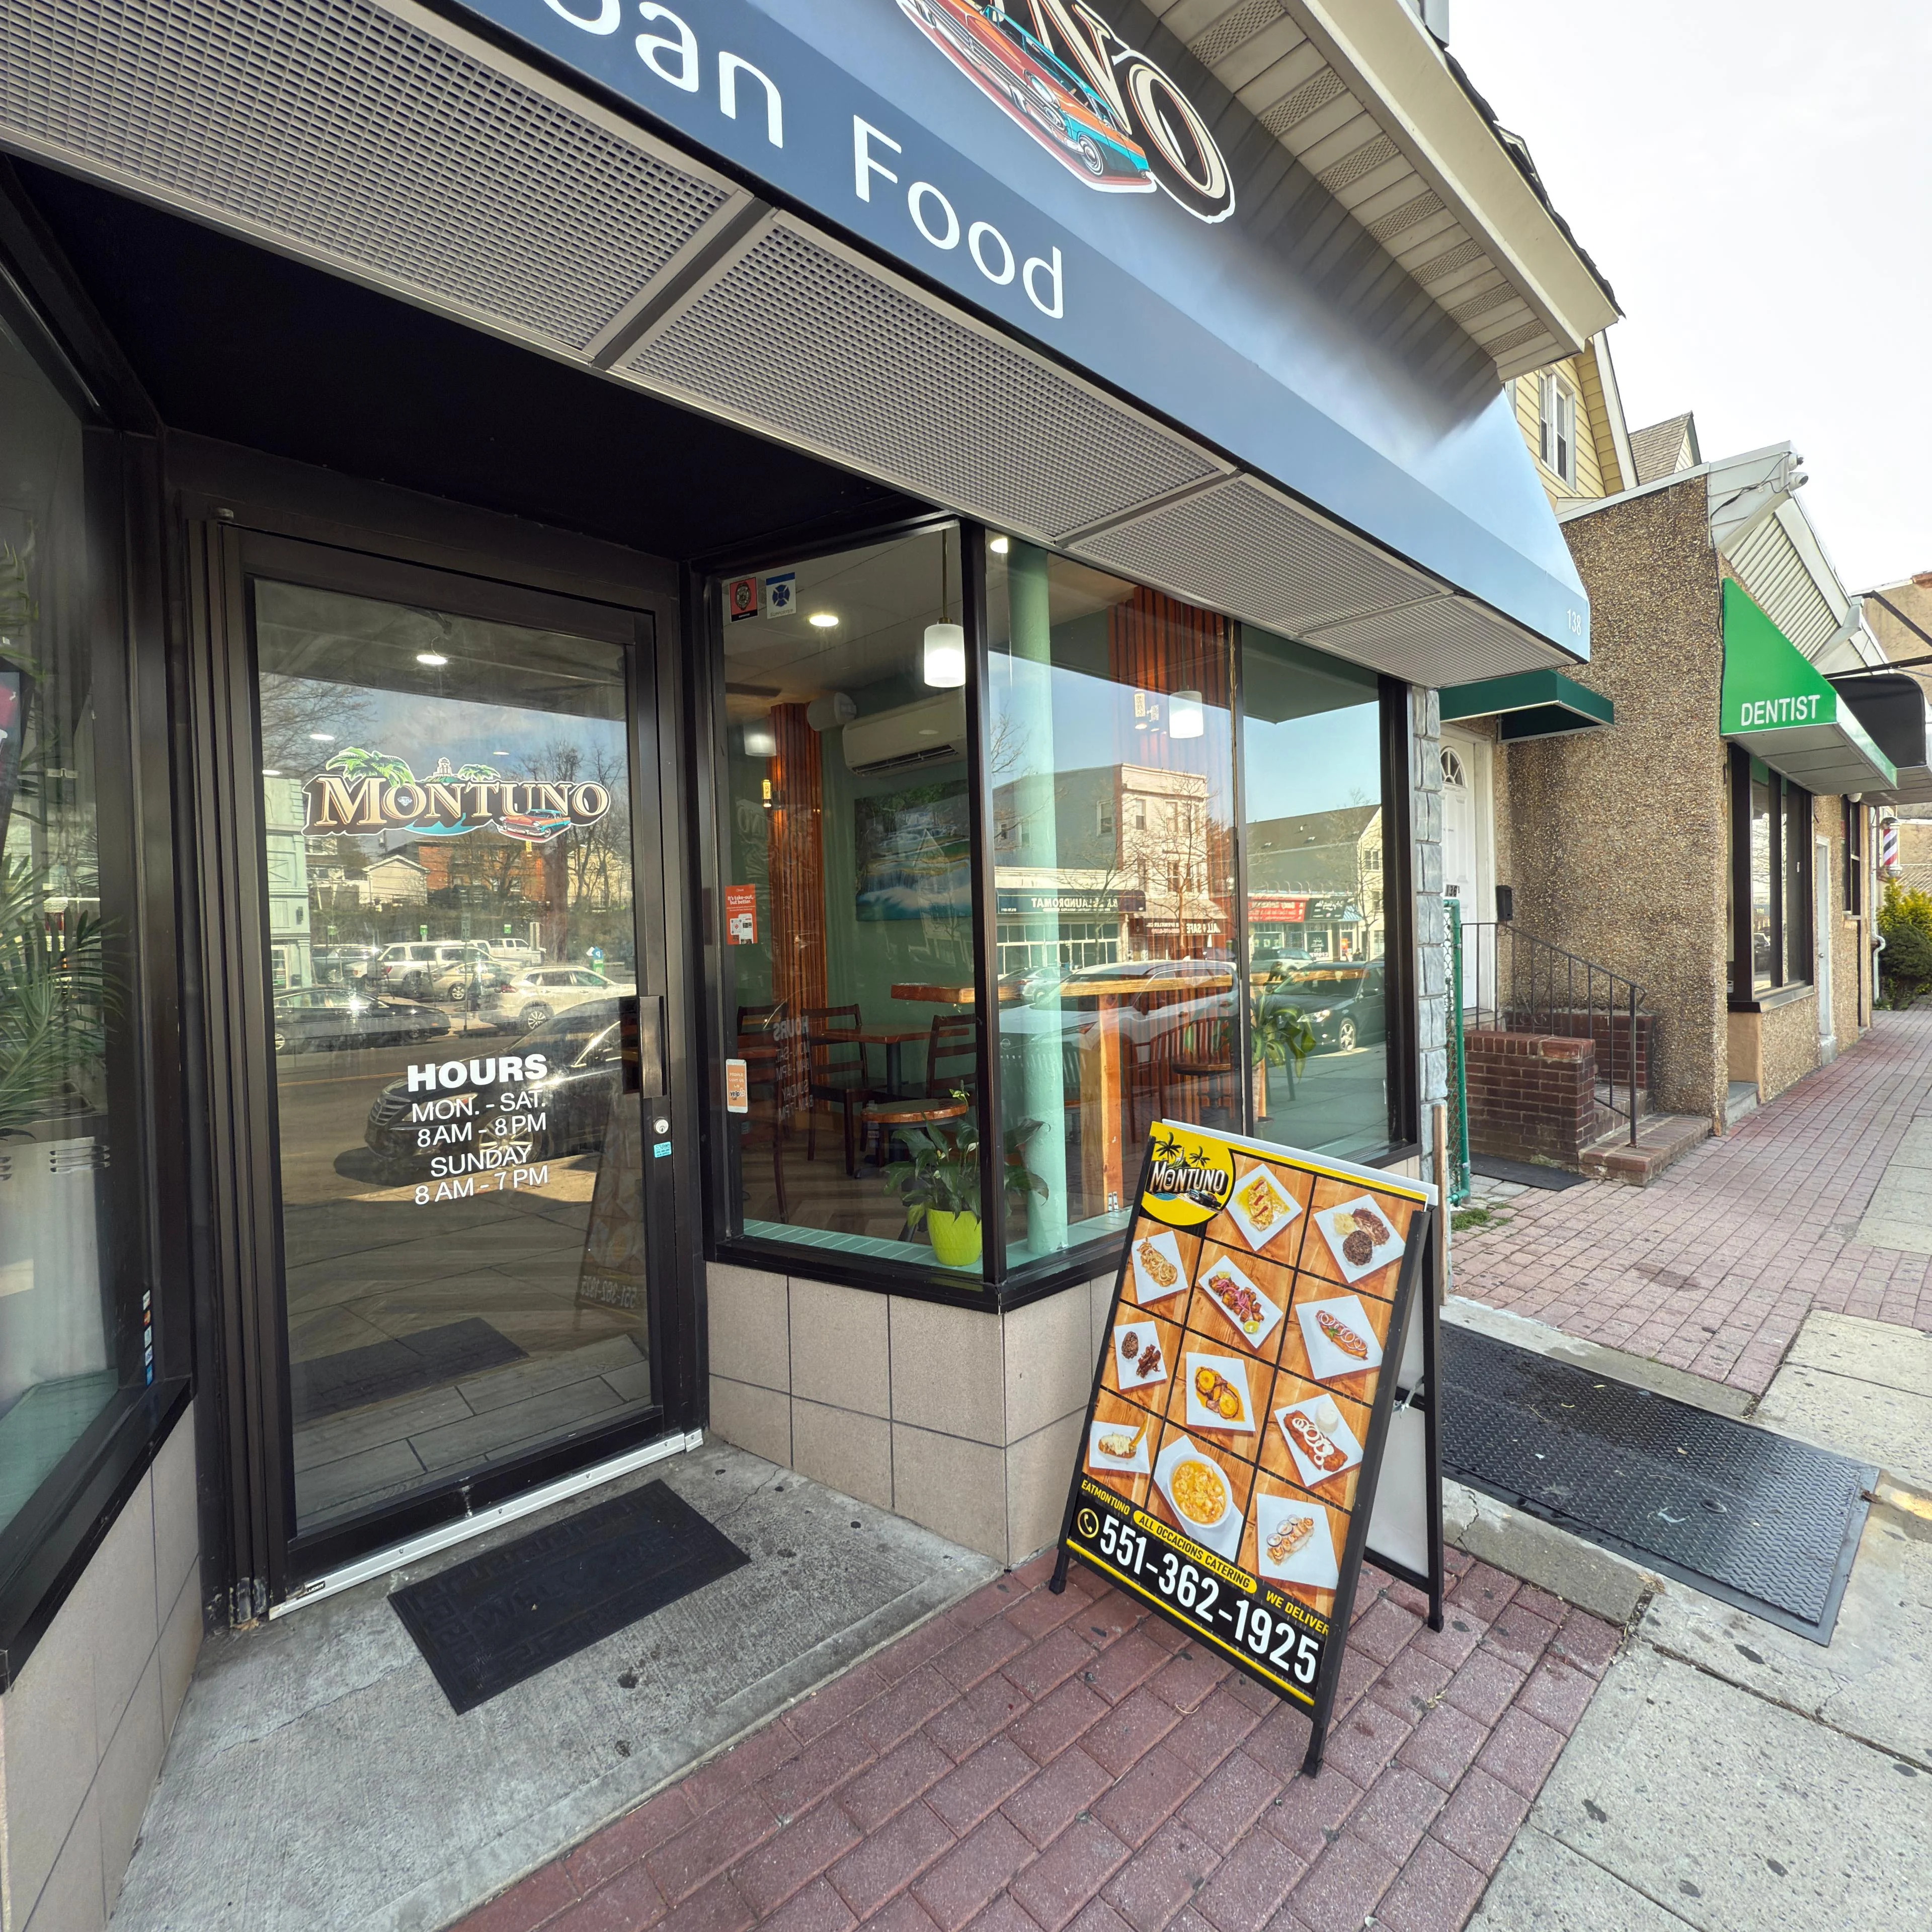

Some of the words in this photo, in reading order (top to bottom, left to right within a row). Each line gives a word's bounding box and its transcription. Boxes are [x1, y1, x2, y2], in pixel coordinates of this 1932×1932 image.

[853, 115, 1063, 319] Food
[1566, 608, 1581, 636] 138
[1741, 694, 1820, 726] DENTIST
[314, 776, 609, 827] MONTUNO
[407, 1054, 548, 1092] HOURS
[412, 1097, 479, 1123] MON.
[500, 1089, 546, 1112] SAT.
[430, 1144, 532, 1177] SUNDAY
[513, 1165, 548, 1188] PM
[1149, 1160, 1227, 1193] MONTUNO
[1081, 1479, 1131, 1515] EATMONTUNO
[1139, 1515, 1154, 1532] ALL
[1156, 1526, 1204, 1560] OCCACIONS
[1204, 1555, 1251, 1589] CATERING
[1100, 1514, 1319, 1683] 551-362-1925
[1266, 1590, 1284, 1609] WE
[1284, 1601, 1329, 1635] DELIVER
